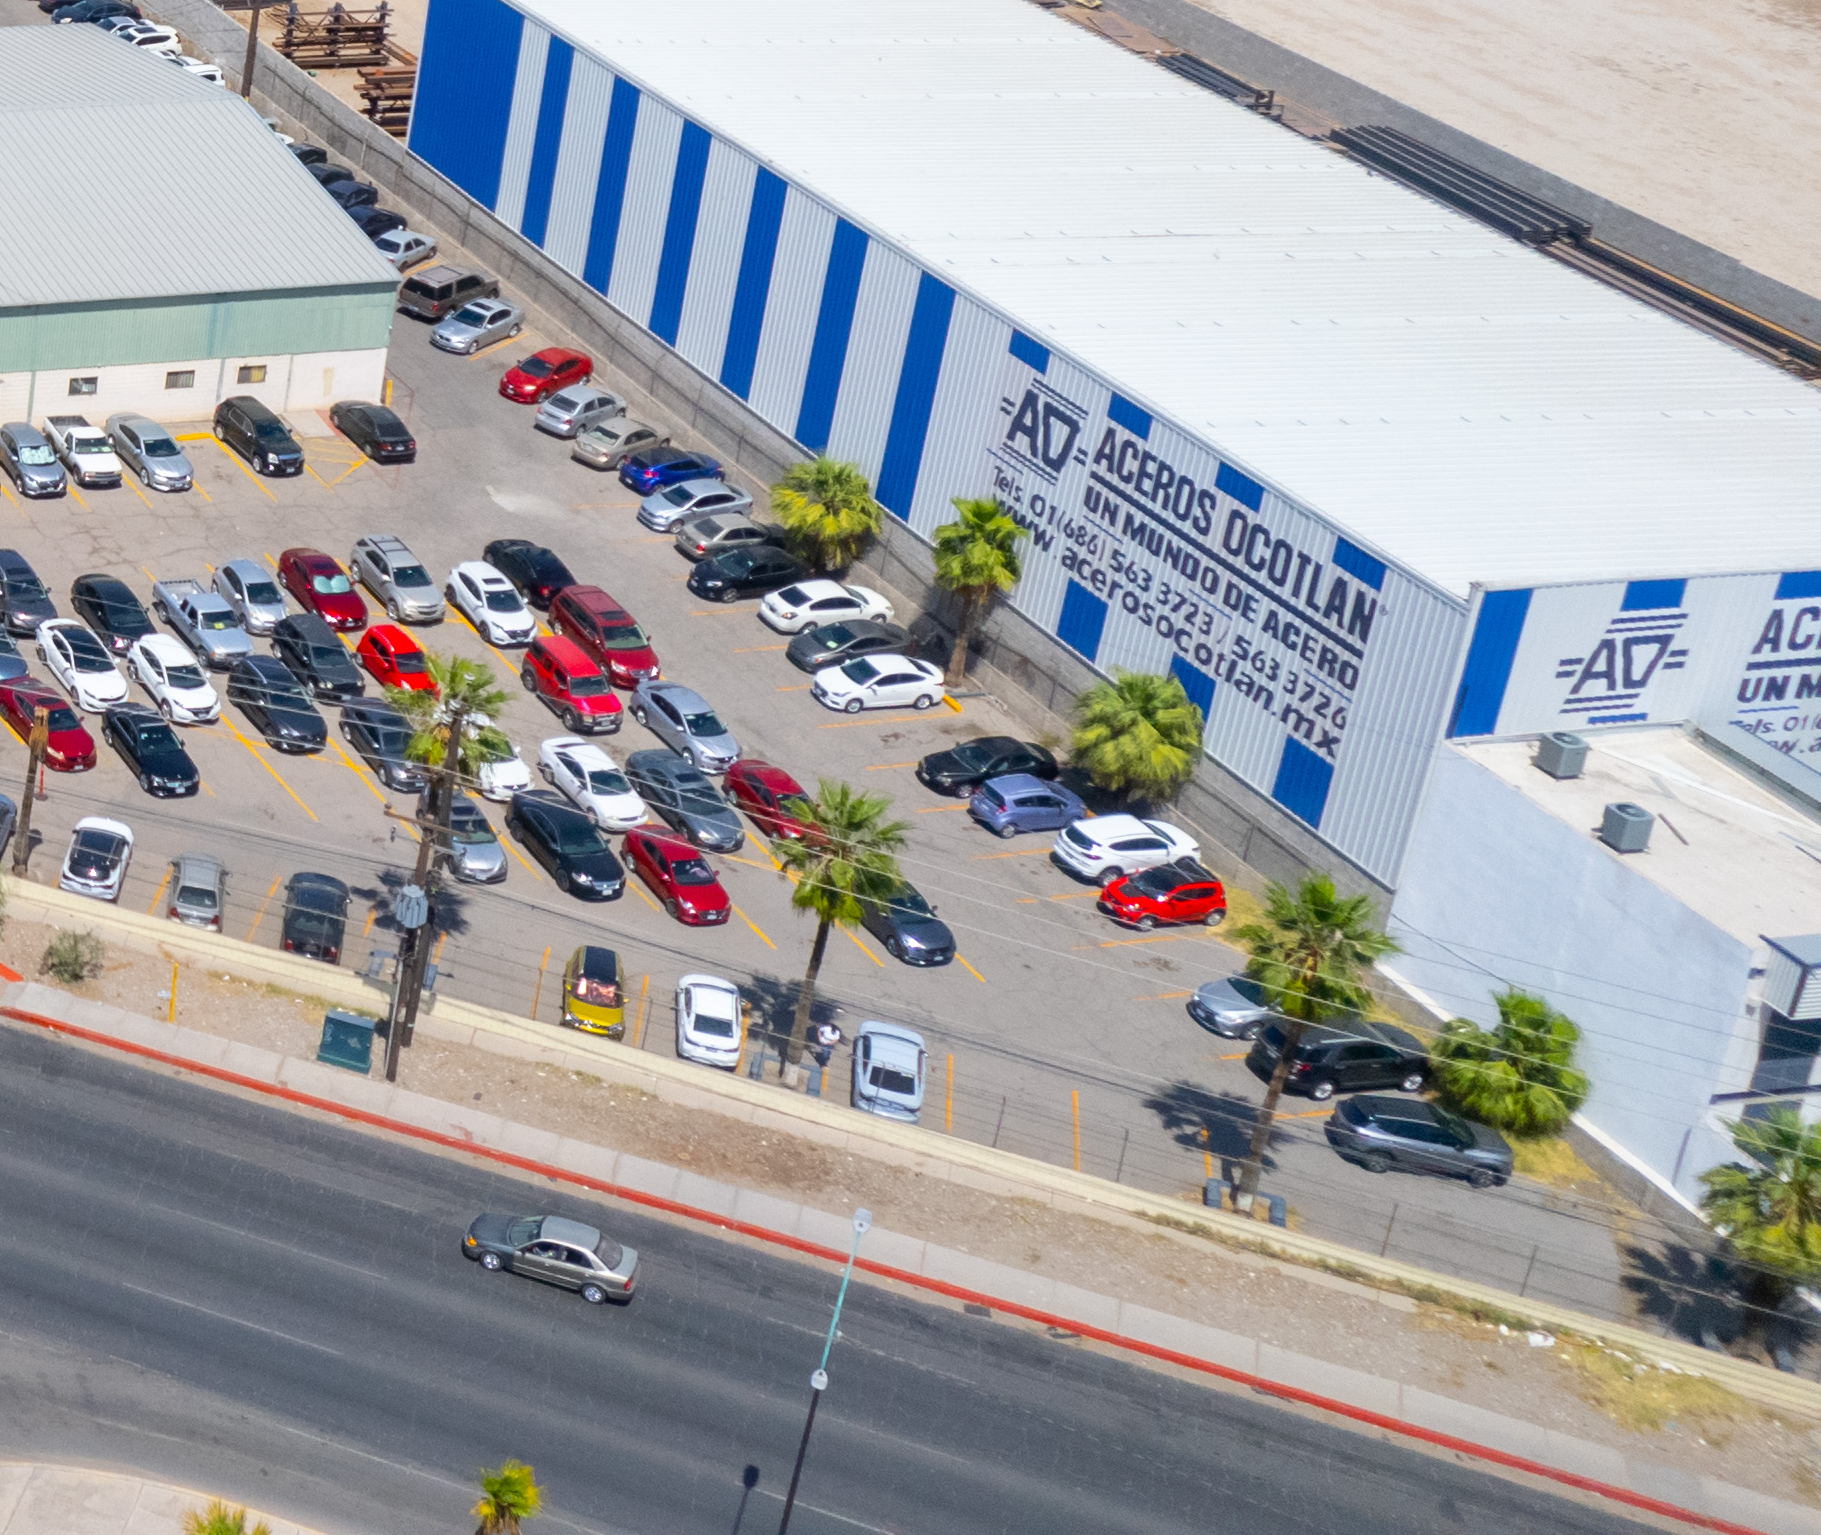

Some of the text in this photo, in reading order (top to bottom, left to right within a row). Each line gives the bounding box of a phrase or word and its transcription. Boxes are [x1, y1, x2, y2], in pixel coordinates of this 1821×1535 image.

[992, 465, 1024, 506] Tels.
[1109, 548, 1153, 593] 563
[1156, 581, 1215, 637] 3723
[1230, 634, 1281, 683] 563
[1282, 670, 1348, 731] 3726
[1083, 484, 1360, 692] UN MUNDO DE ACERO
[1093, 425, 1378, 645] ACEROS OCOTLAN
[1751, 605, 1821, 655] AC
[1737, 675, 1791, 704] UN
